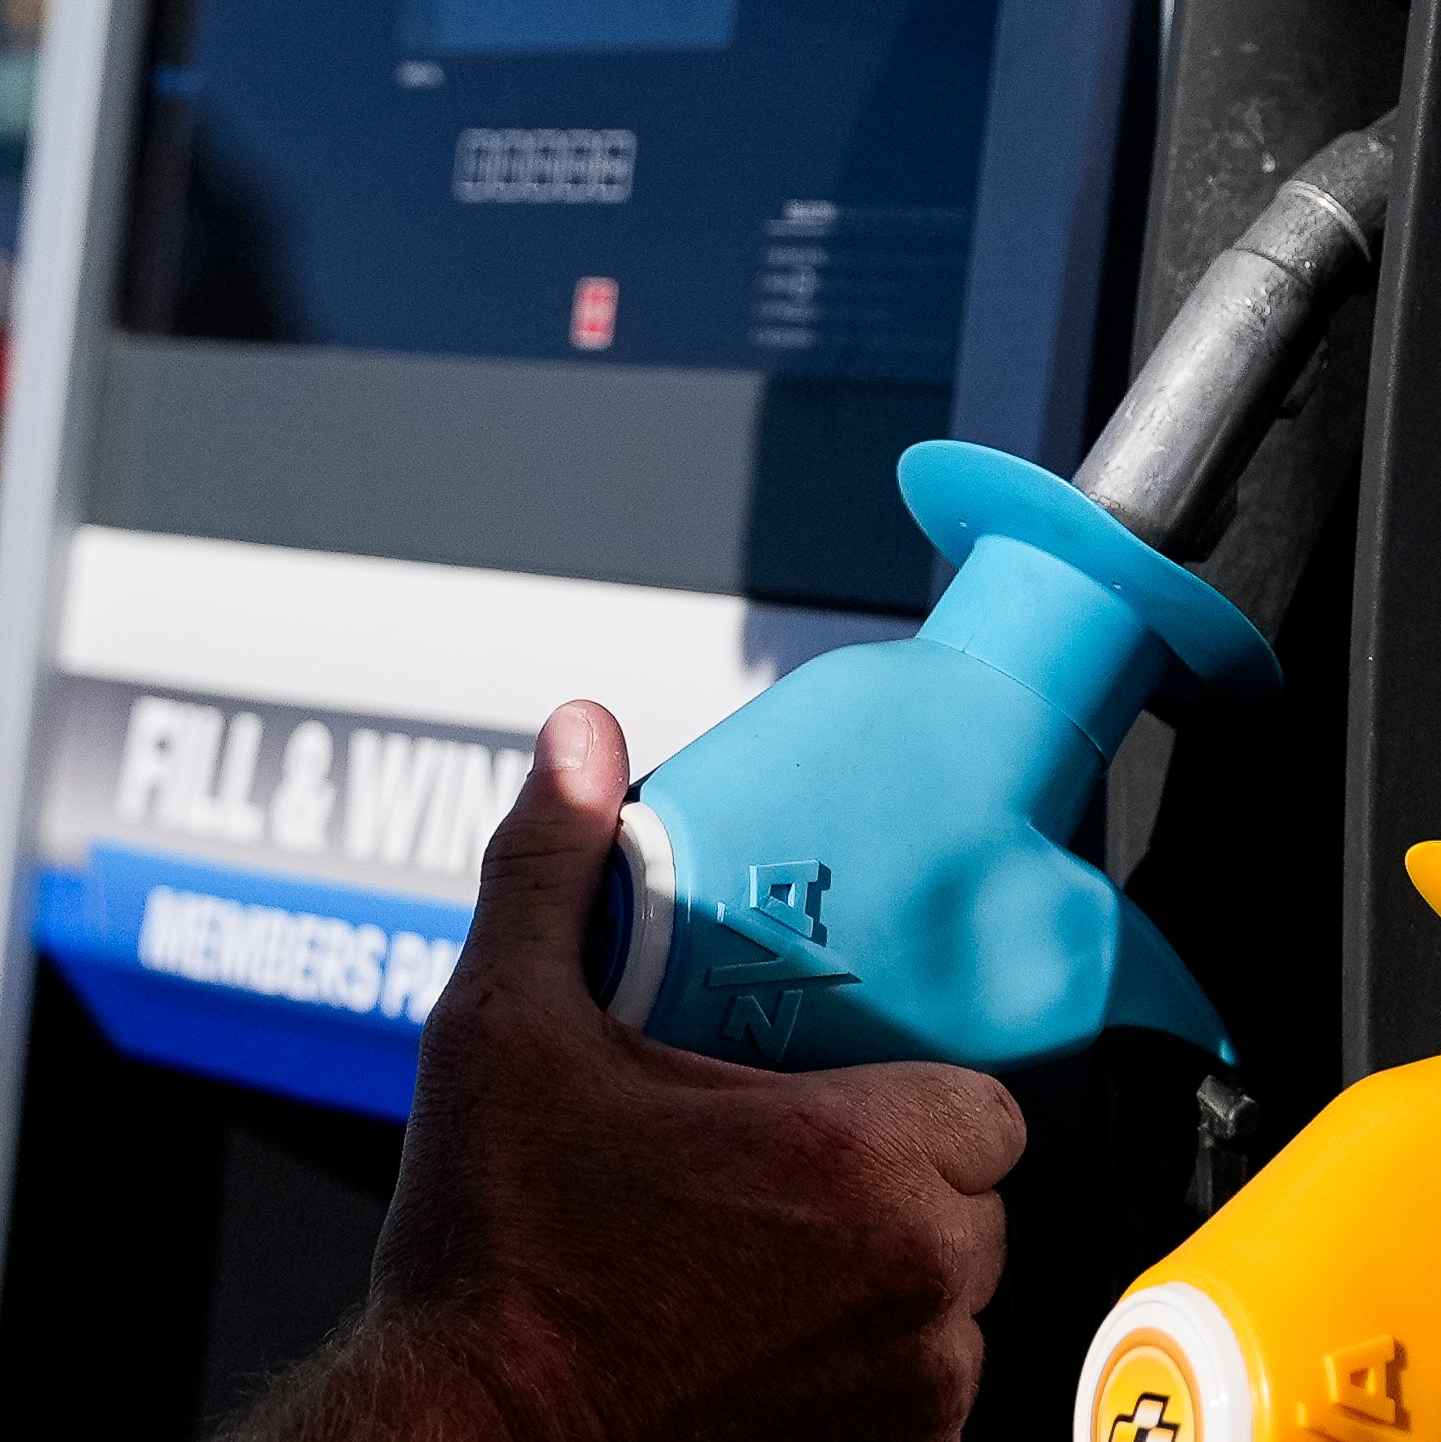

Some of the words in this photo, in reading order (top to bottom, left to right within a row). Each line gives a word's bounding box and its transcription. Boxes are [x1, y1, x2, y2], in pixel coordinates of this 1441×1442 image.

[114, 697, 266, 838] FILL
[268, 718, 338, 852] &
[137, 885, 389, 1017] MEMBERS
